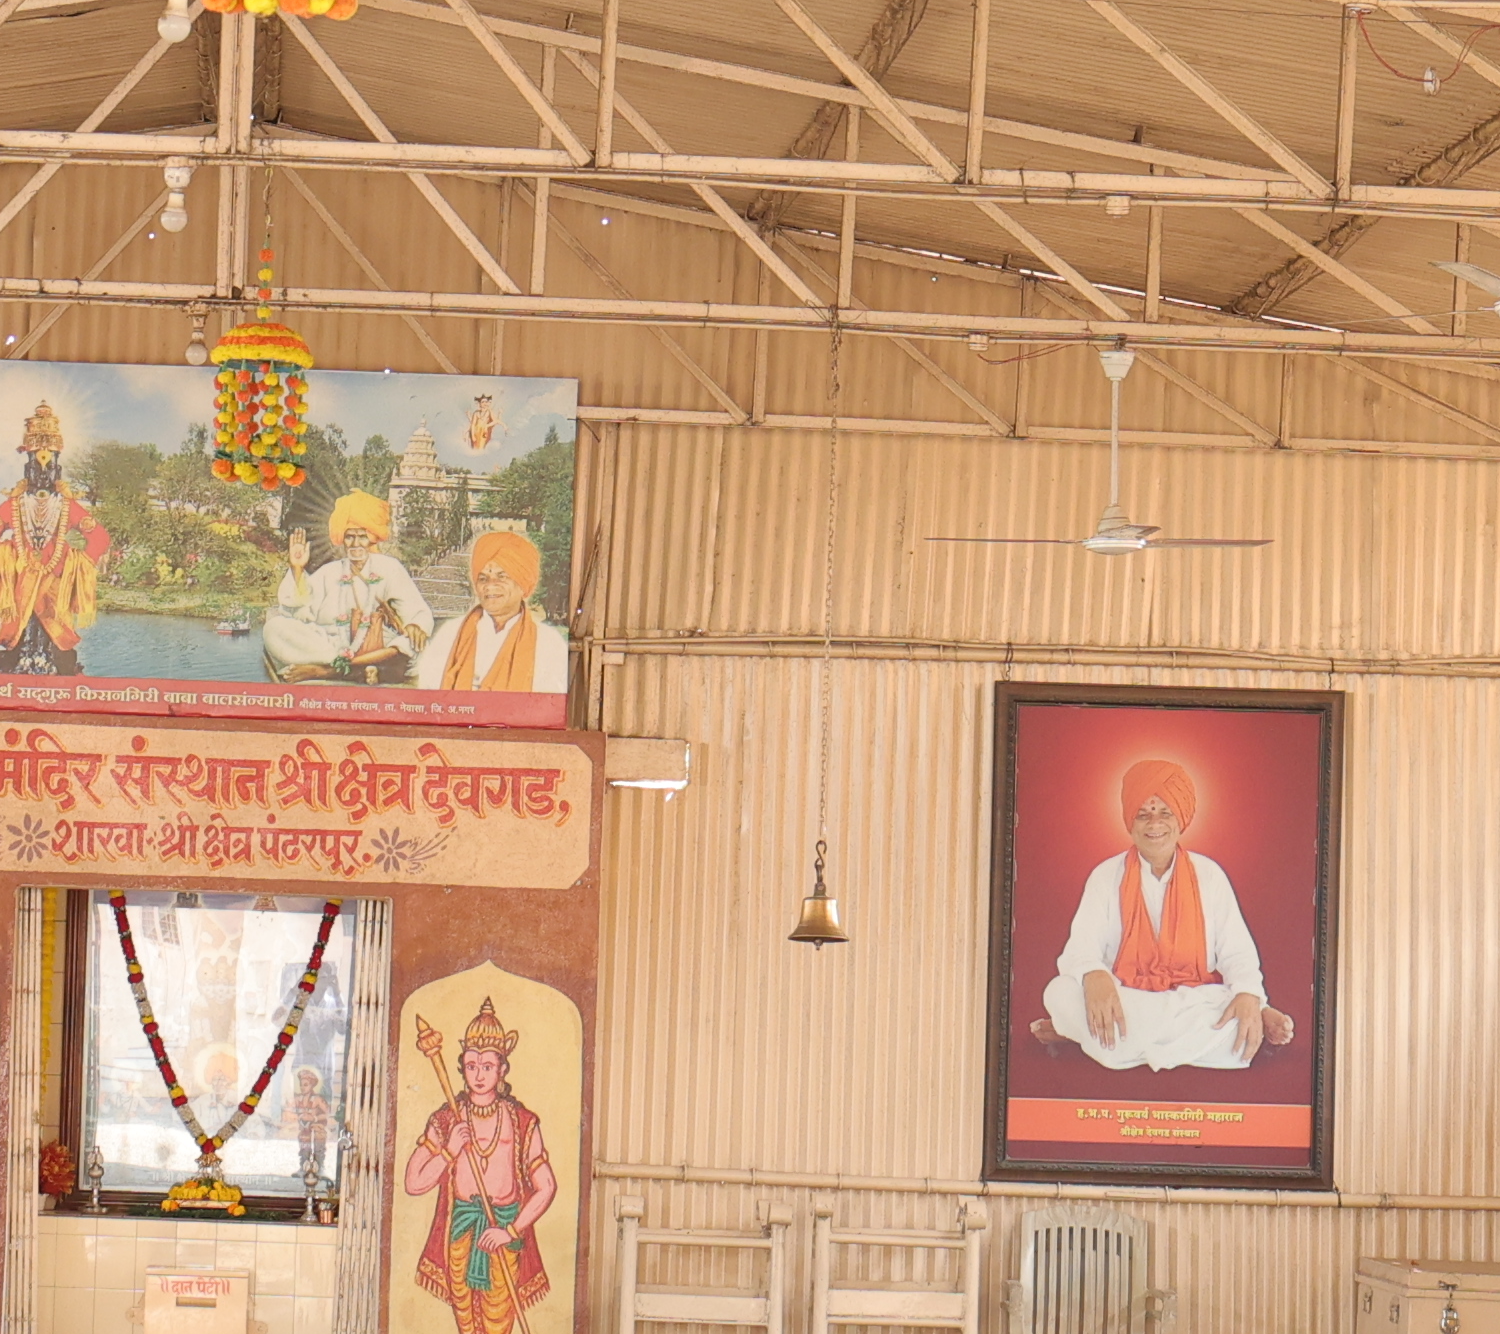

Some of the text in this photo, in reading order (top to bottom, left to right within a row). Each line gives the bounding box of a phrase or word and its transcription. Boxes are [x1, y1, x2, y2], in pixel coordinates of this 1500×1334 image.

[75, 686, 158, 703] किसनगिरी
[164, 692, 198, 705] बाबा
[110, 735, 274, 810] संस्थान
[1152, 1108, 1204, 1122] भास्करगिरी
[1206, 1111, 1244, 1123] महाराज
